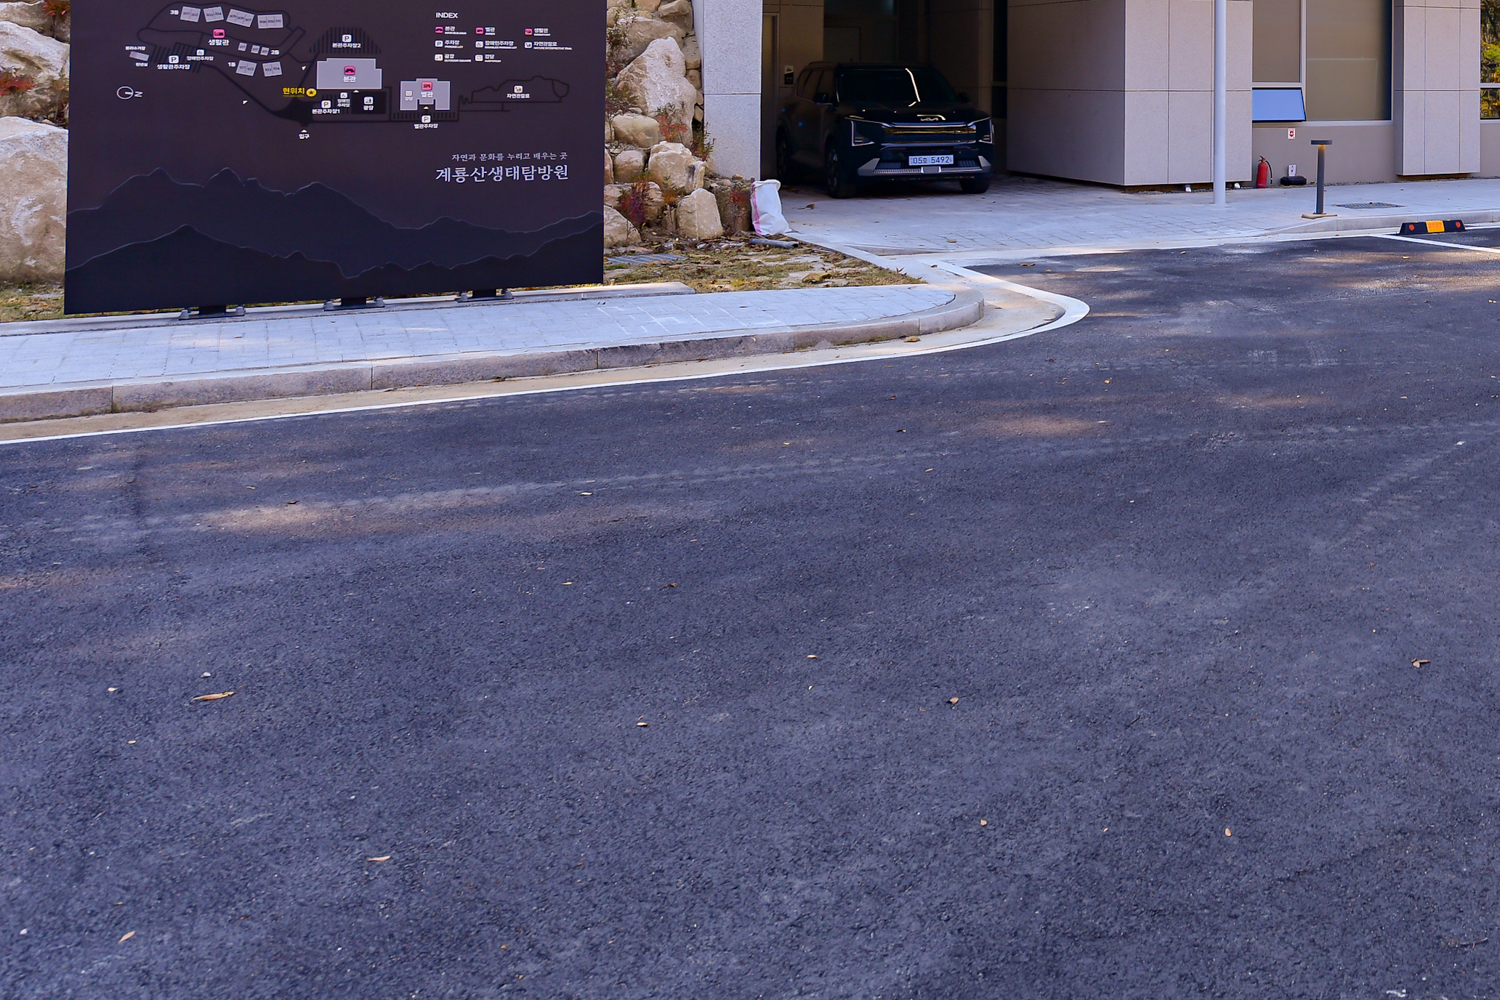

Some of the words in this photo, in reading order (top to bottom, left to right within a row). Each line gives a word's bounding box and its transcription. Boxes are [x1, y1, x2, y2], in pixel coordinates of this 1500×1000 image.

[283, 87, 305, 95] 현위치
[452, 153, 476, 162] 자연과
[479, 153, 504, 161] 문화를
[507, 152, 531, 160] 누리고
[533, 152, 557, 160] 배우는
[560, 151, 568, 160] 곳
[931, 156, 950, 164] 5492
[435, 164, 569, 183] 계룡산생태탐방원
